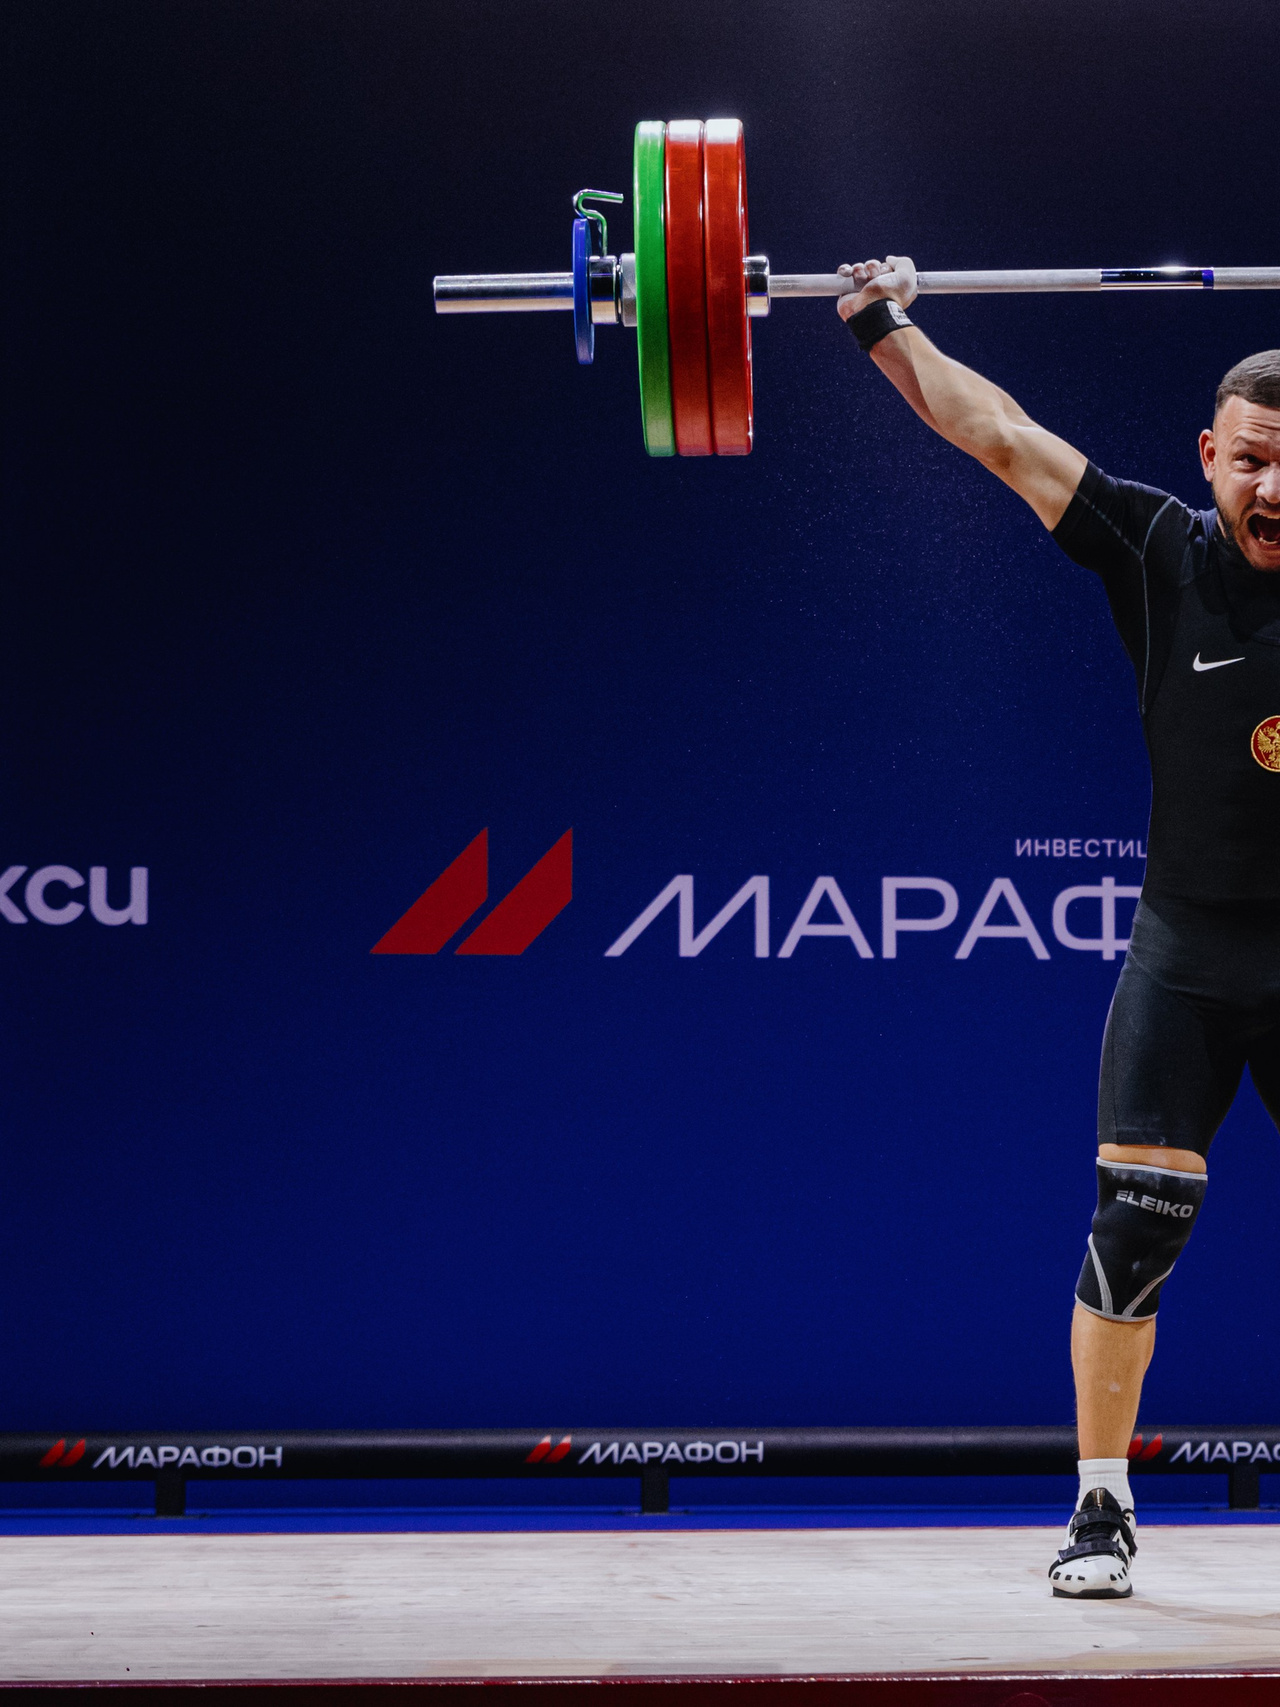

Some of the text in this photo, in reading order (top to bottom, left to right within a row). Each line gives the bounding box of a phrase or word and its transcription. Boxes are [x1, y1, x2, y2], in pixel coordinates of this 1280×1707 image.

[1115, 1189, 1194, 1219] ELEIKO
[92, 1445, 283, 1468] МАРАФОН
[577, 1440, 764, 1464] МАРАФОН
